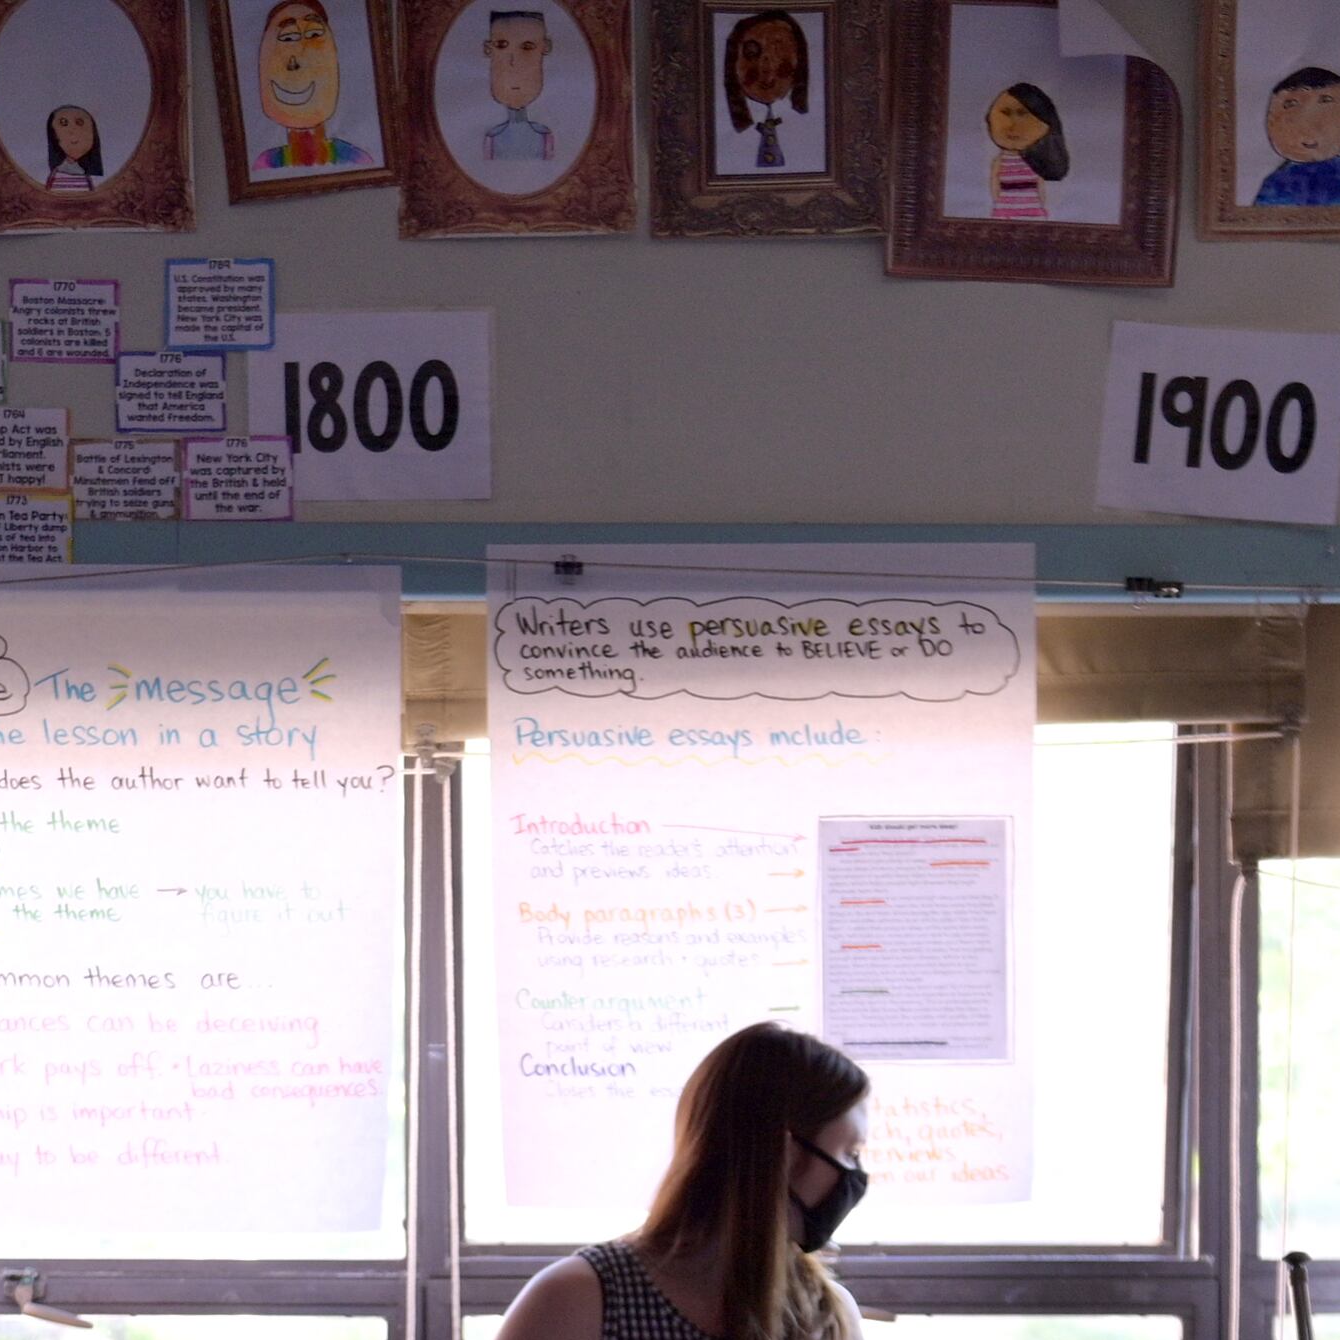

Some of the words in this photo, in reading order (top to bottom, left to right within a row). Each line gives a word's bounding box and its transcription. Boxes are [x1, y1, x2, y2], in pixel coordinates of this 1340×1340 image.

[3, 410, 25, 419] 1764
[282, 358, 462, 454] 1800
[11, 424, 32, 435] Act
[34, 426, 58, 435] was
[1134, 371, 1317, 474] 1900
[8, 437, 23, 449] by
[26, 437, 64, 449] English
[25, 463, 56, 472] were
[515, 607, 609, 637] Writers
[629, 618, 674, 639] use
[688, 615, 830, 655] persuasive
[848, 615, 940, 647] essays
[958, 613, 987, 636] to
[519, 641, 619, 659] convince
[632, 641, 664, 659] the
[675, 639, 765, 659] audience
[775, 641, 793, 657] to
[802, 641, 882, 659] BELIEVE
[890, 645, 909, 658] or
[917, 637, 953, 657] DO
[35, 668, 97, 702] The
[524, 663, 644, 690] something.
[42, 717, 138, 747] lesson
[158, 722, 182, 745] in
[199, 729, 219, 748] a
[236, 719, 318, 759] story
[514, 717, 654, 749] Persuasive
[669, 727, 753, 758] essays
[56, 764, 97, 791] the
[110, 764, 184, 791] author
[194, 766, 250, 791] want
[262, 767, 282, 791] to
[291, 766, 327, 790] tell
[337, 763, 397, 798] you?
[511, 811, 652, 837] Introduction
[519, 1053, 637, 1077] Conclusion
